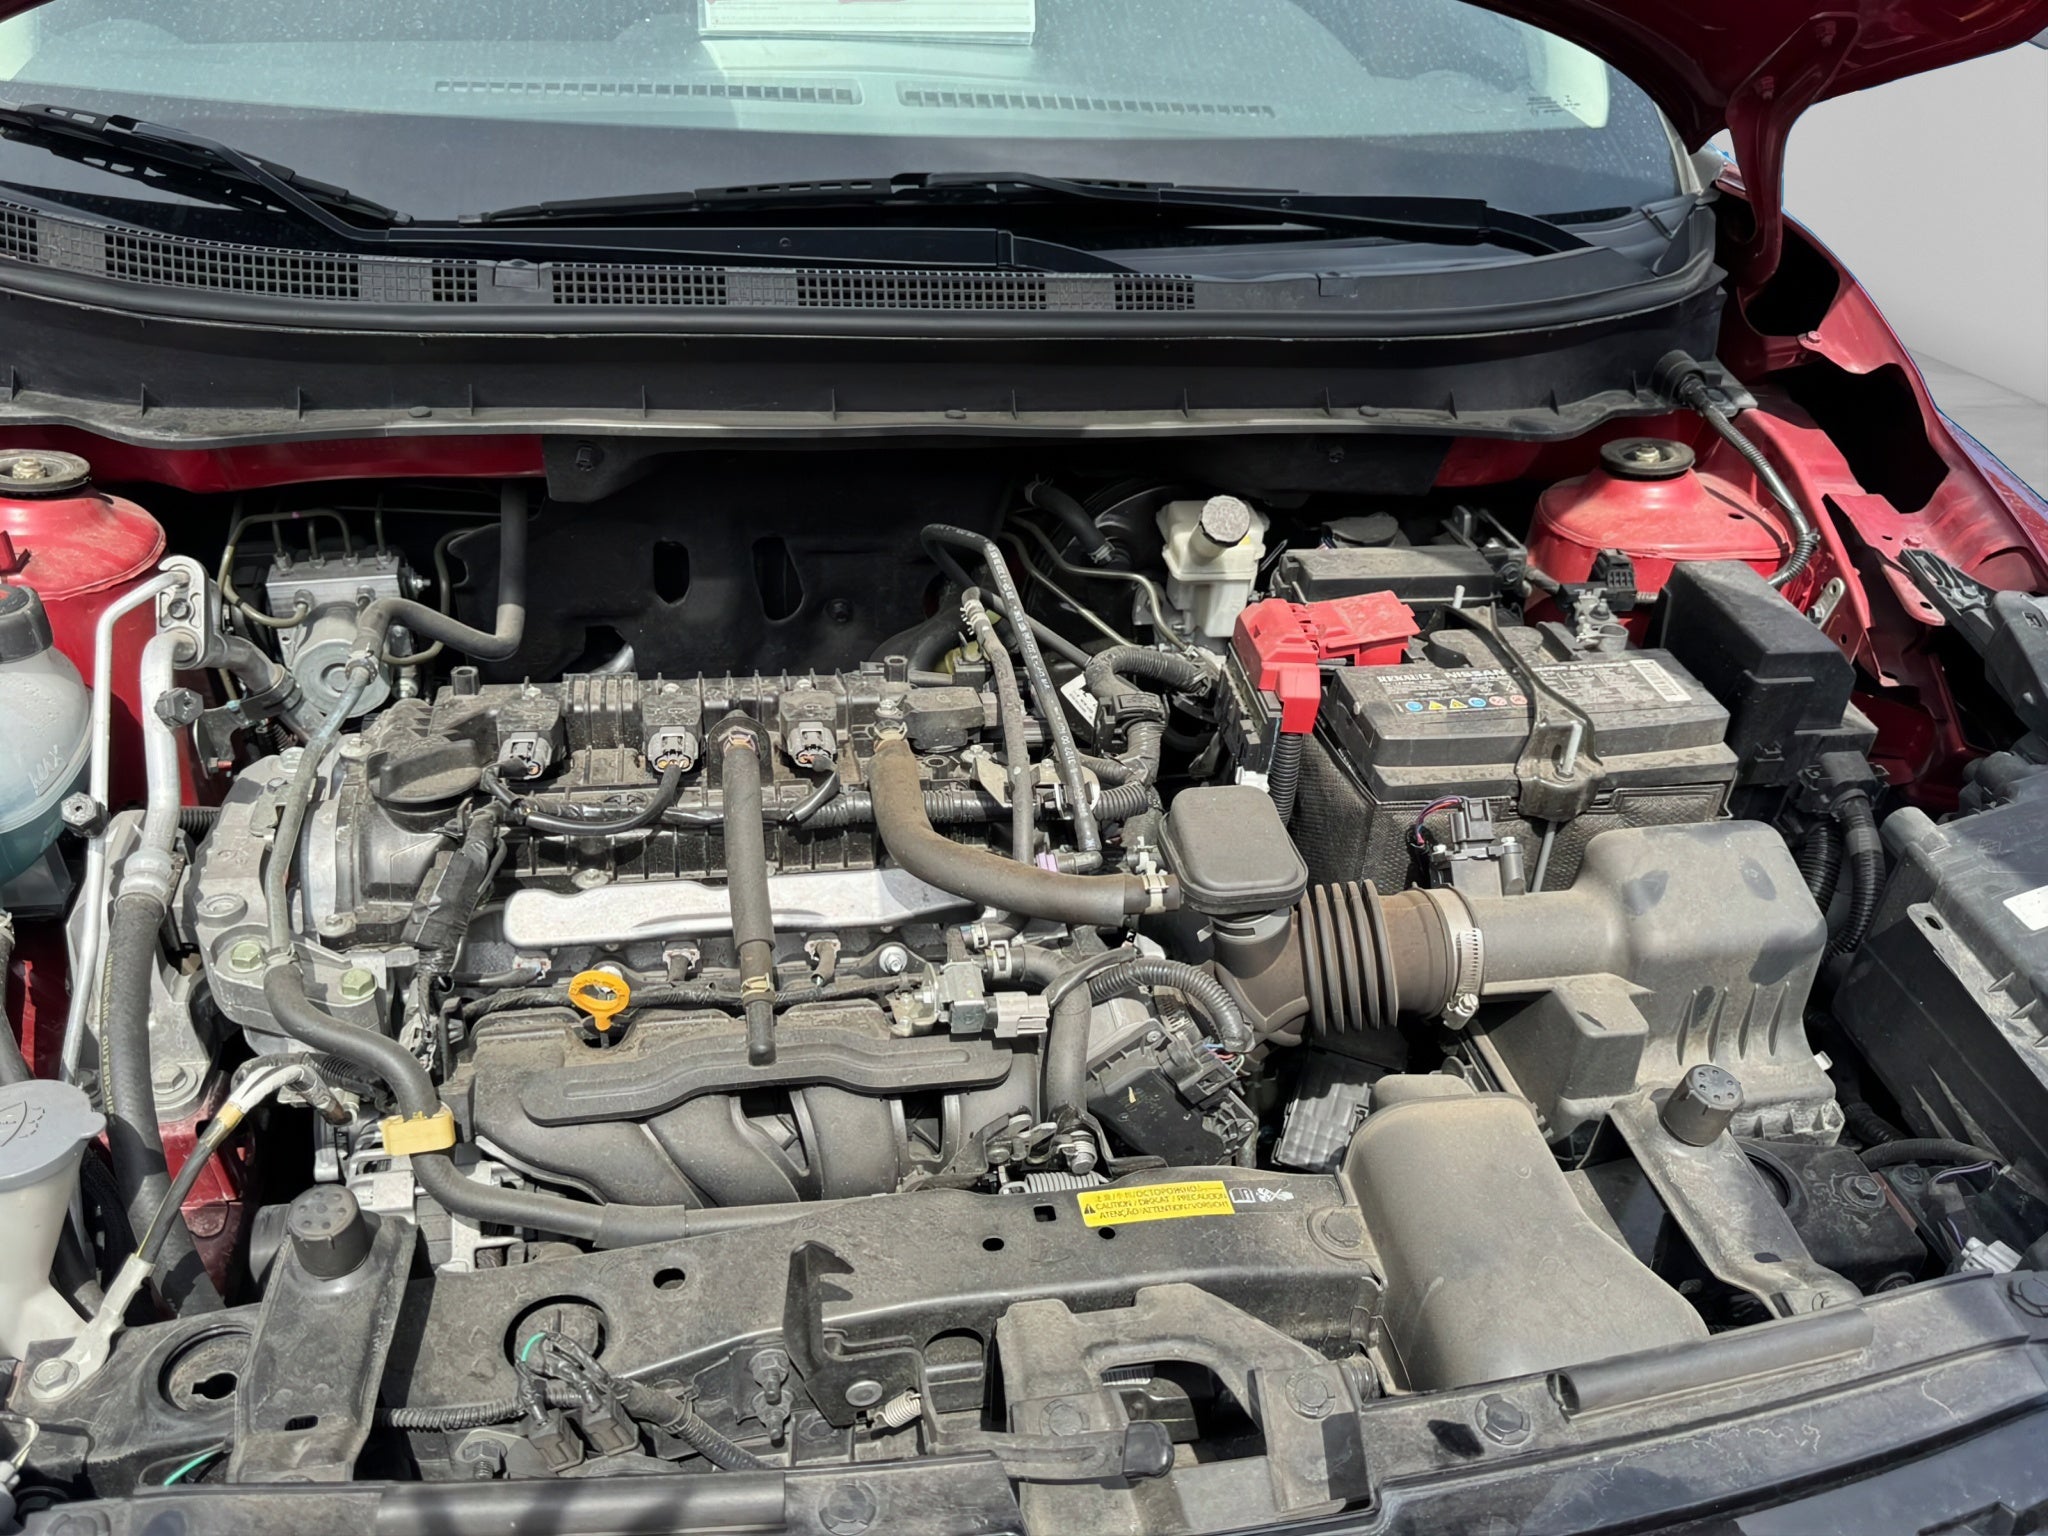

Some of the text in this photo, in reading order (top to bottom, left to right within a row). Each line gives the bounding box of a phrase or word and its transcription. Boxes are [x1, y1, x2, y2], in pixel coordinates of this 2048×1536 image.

[1376, 673, 1433, 683] RENAULT
[1444, 668, 1508, 679] NISSAN
[1095, 1201, 1132, 1210] CAUTION
